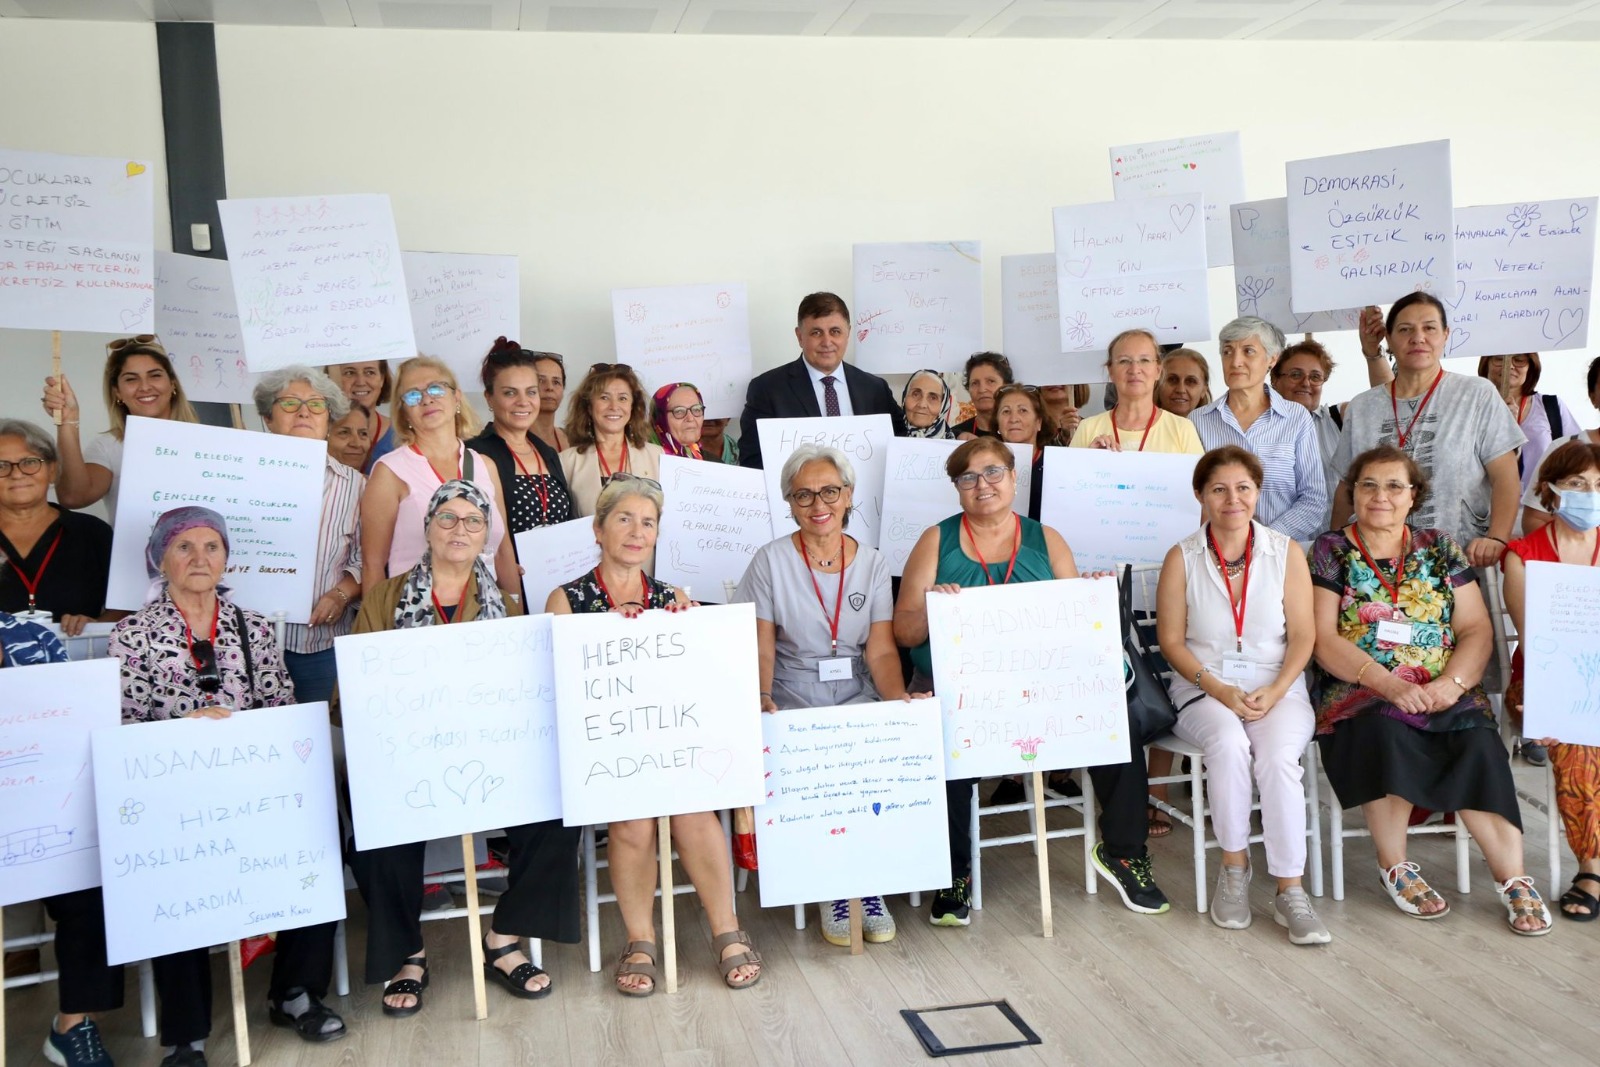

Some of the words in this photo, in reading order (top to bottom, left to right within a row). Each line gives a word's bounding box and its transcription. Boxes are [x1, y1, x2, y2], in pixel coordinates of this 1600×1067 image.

[0, 214, 62, 231] ĞİTİM
[1328, 200, 1420, 228] ÖZGÜRLÜK
[1073, 227, 1124, 249] HALKIN
[1331, 229, 1408, 249] EŞİTLİK
[1139, 281, 1185, 293] DESTEK
[1475, 288, 1538, 301] KONAKLAMA
[155, 446, 178, 457] BEN
[195, 451, 243, 464] BELEDİYE
[692, 485, 769, 501] MAHALLELERD
[676, 502, 720, 516] SOSYAL
[682, 520, 742, 535] ALANLARINI
[582, 632, 686, 670] HERKES
[788, 724, 808, 732] Ben
[585, 746, 703, 785] ADALET
[114, 837, 236, 878] YAŞLILARA
[239, 854, 288, 874] BAKIM
